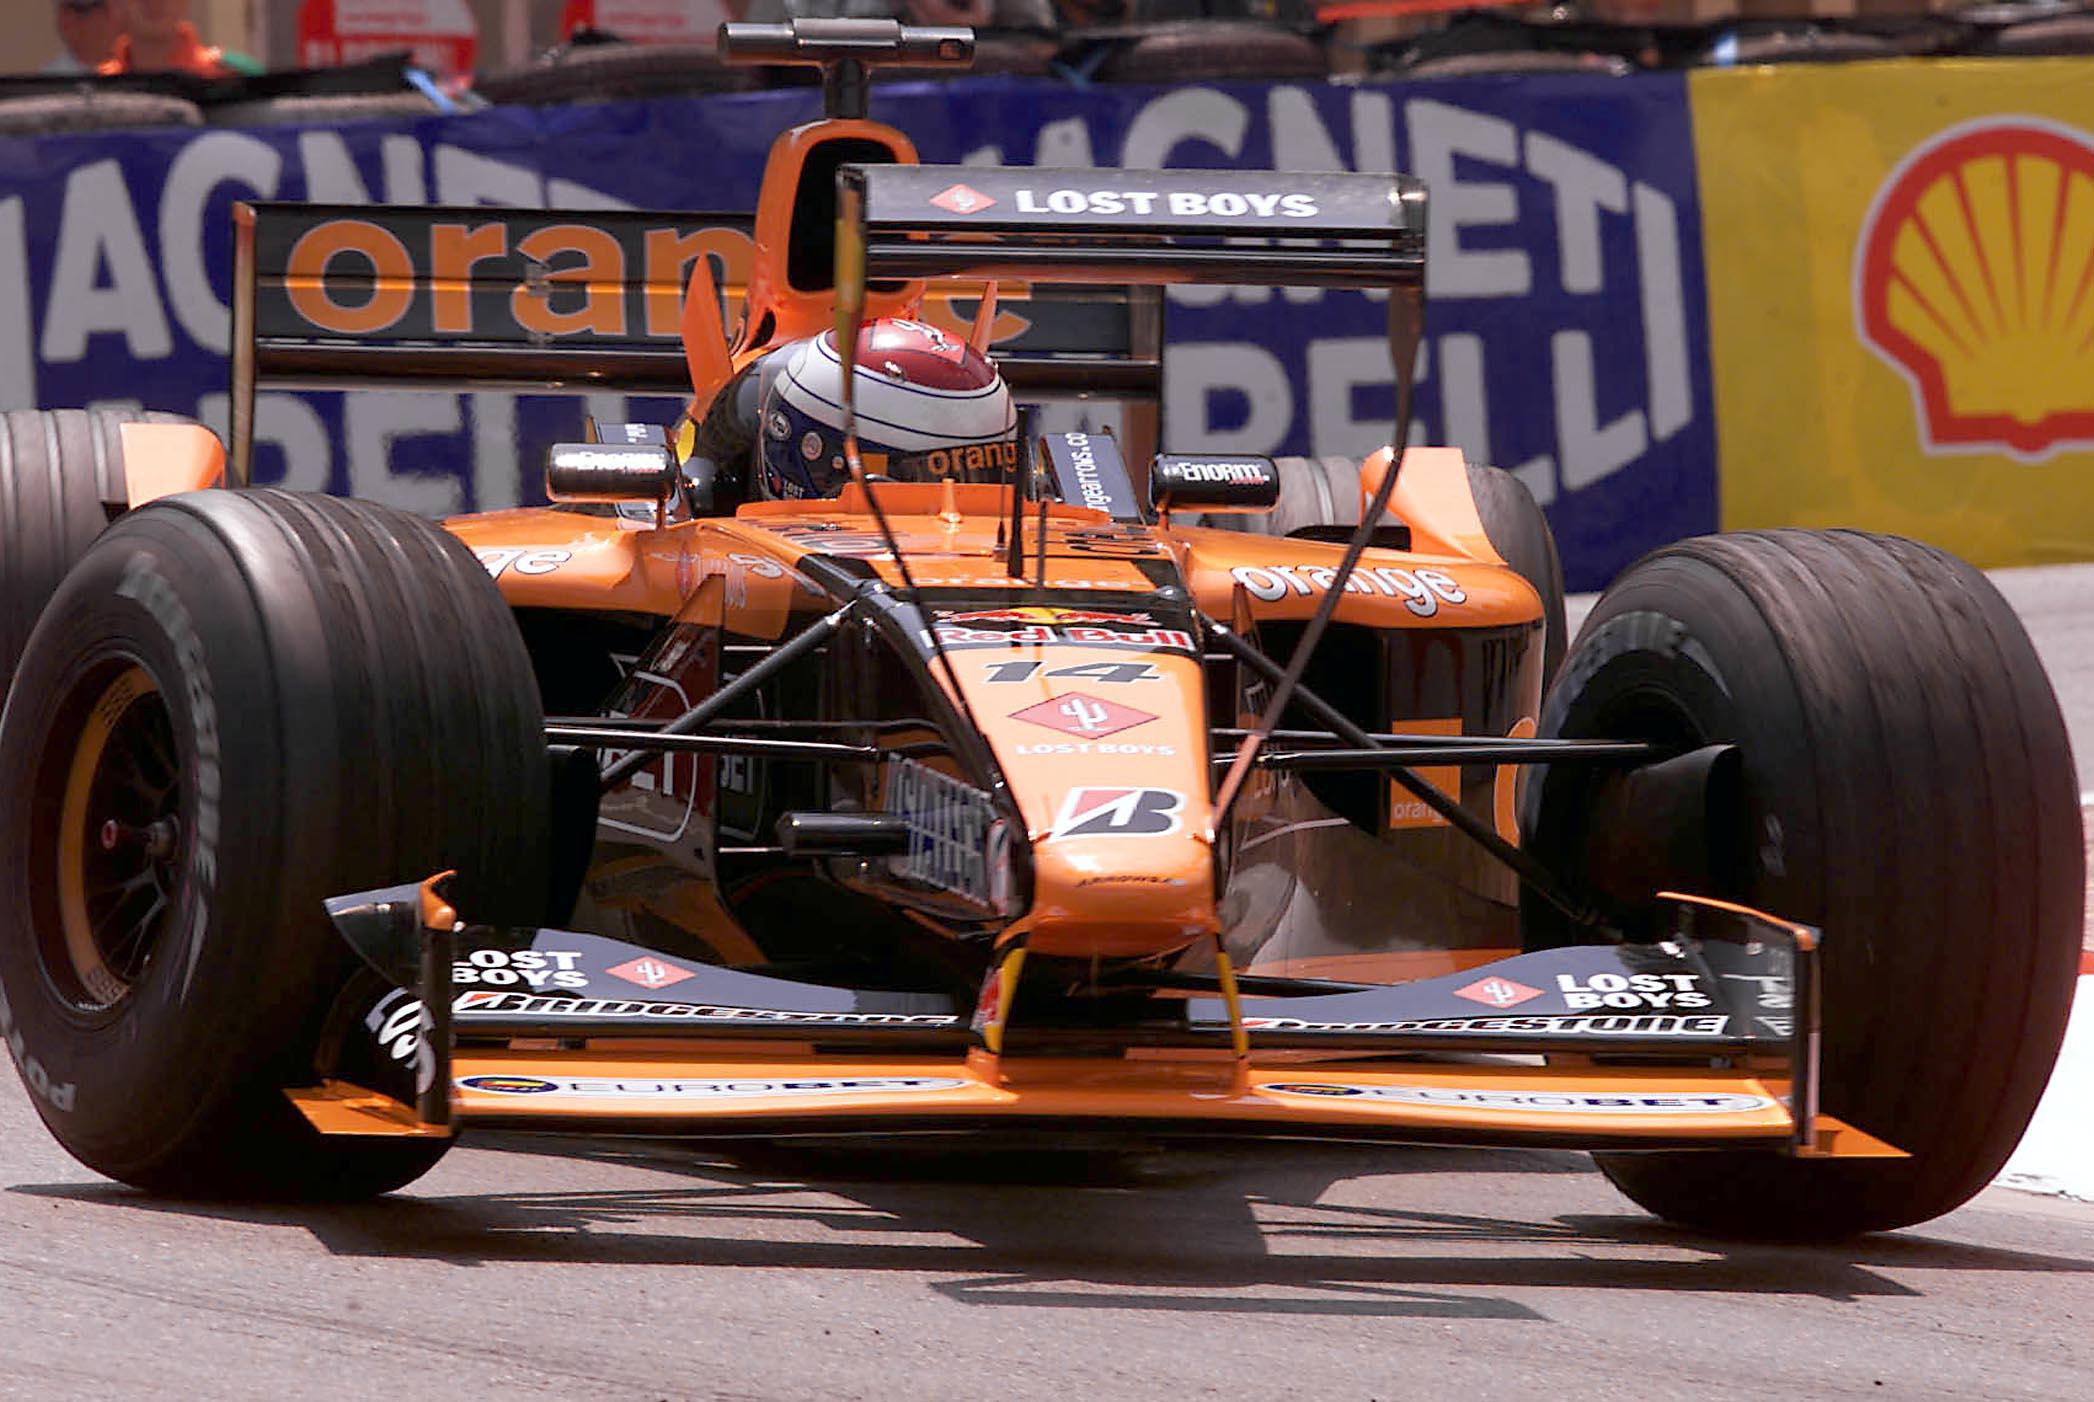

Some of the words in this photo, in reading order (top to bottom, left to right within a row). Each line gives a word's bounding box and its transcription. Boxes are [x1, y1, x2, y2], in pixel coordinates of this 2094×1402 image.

[1015, 189, 1158, 215] LOST
[1168, 191, 1319, 218] BOYS
[285, 218, 1032, 342] oran
[927, 440, 1018, 476] orang
[1230, 564, 1468, 618] orange
[921, 625, 1056, 649] Red
[1071, 627, 1196, 651] Bull
[984, 660, 1161, 683] 14
[1015, 743, 1090, 755] LOST
[1096, 744, 1177, 756] BOYS
[1394, 802, 1442, 822] oran
[452, 950, 583, 970] OST
[452, 968, 590, 988] BOYS
[1556, 974, 1700, 993] LOST
[1562, 992, 1713, 1009] BOYS
